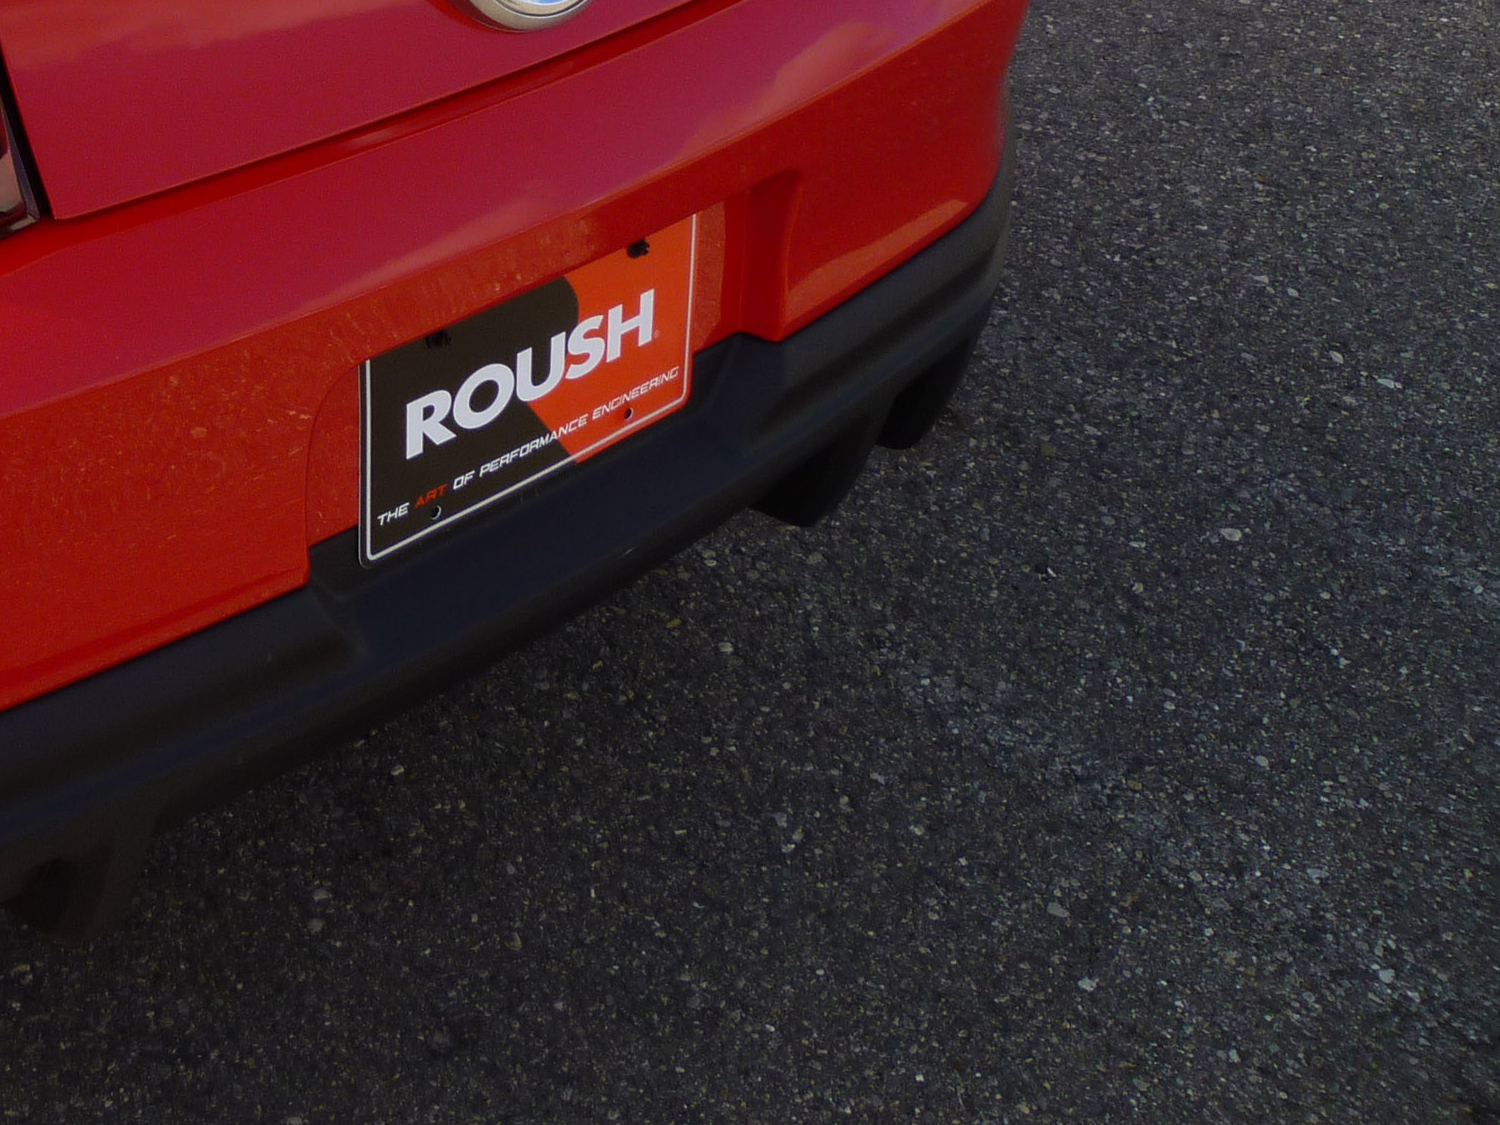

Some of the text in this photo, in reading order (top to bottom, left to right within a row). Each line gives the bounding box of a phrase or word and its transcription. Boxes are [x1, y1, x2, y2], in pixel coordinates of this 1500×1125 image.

[377, 366, 680, 526] THE ART OF PERFORMANCE ENGINEERING
[406, 288, 655, 460] ROUSH
